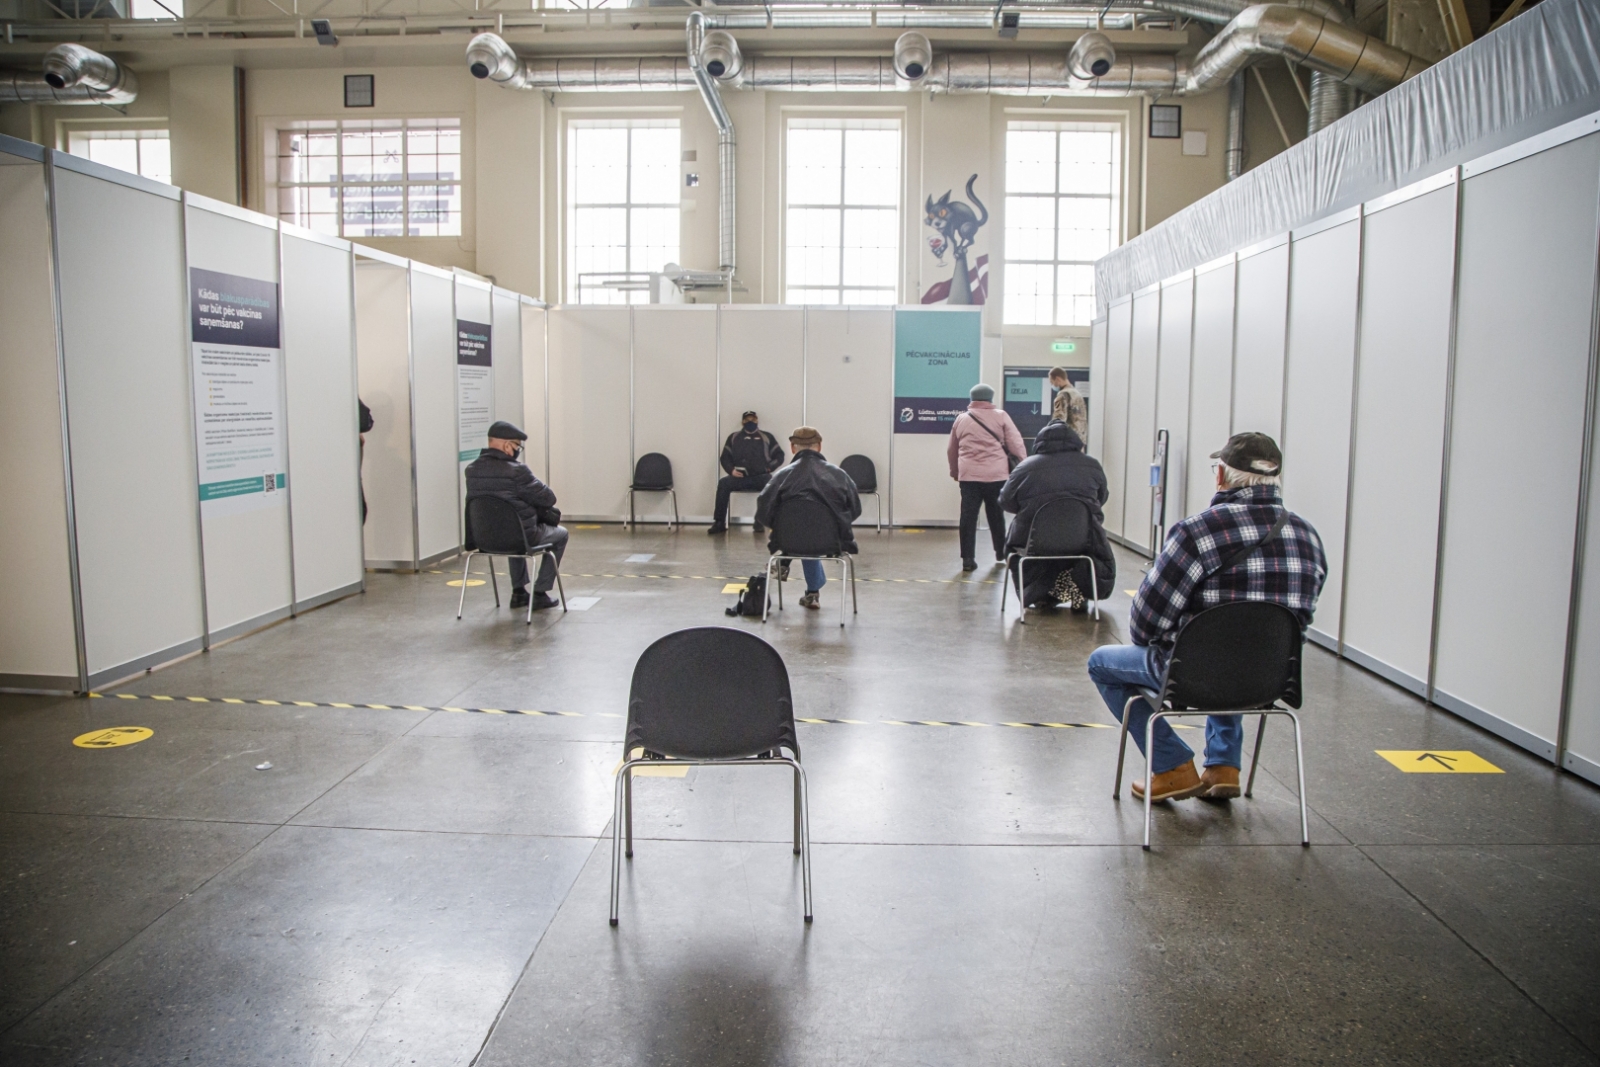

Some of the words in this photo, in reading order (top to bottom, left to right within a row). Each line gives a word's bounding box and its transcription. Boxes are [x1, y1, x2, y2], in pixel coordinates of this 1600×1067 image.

[198, 288, 219, 301] Kādas
[199, 303, 210, 313] var
[210, 303, 222, 315] būt
[223, 305, 235, 317] pēc
[199, 317, 244, 330] saņemšanas?
[905, 350, 971, 359] PĒCVAKCINĀCIJAS
